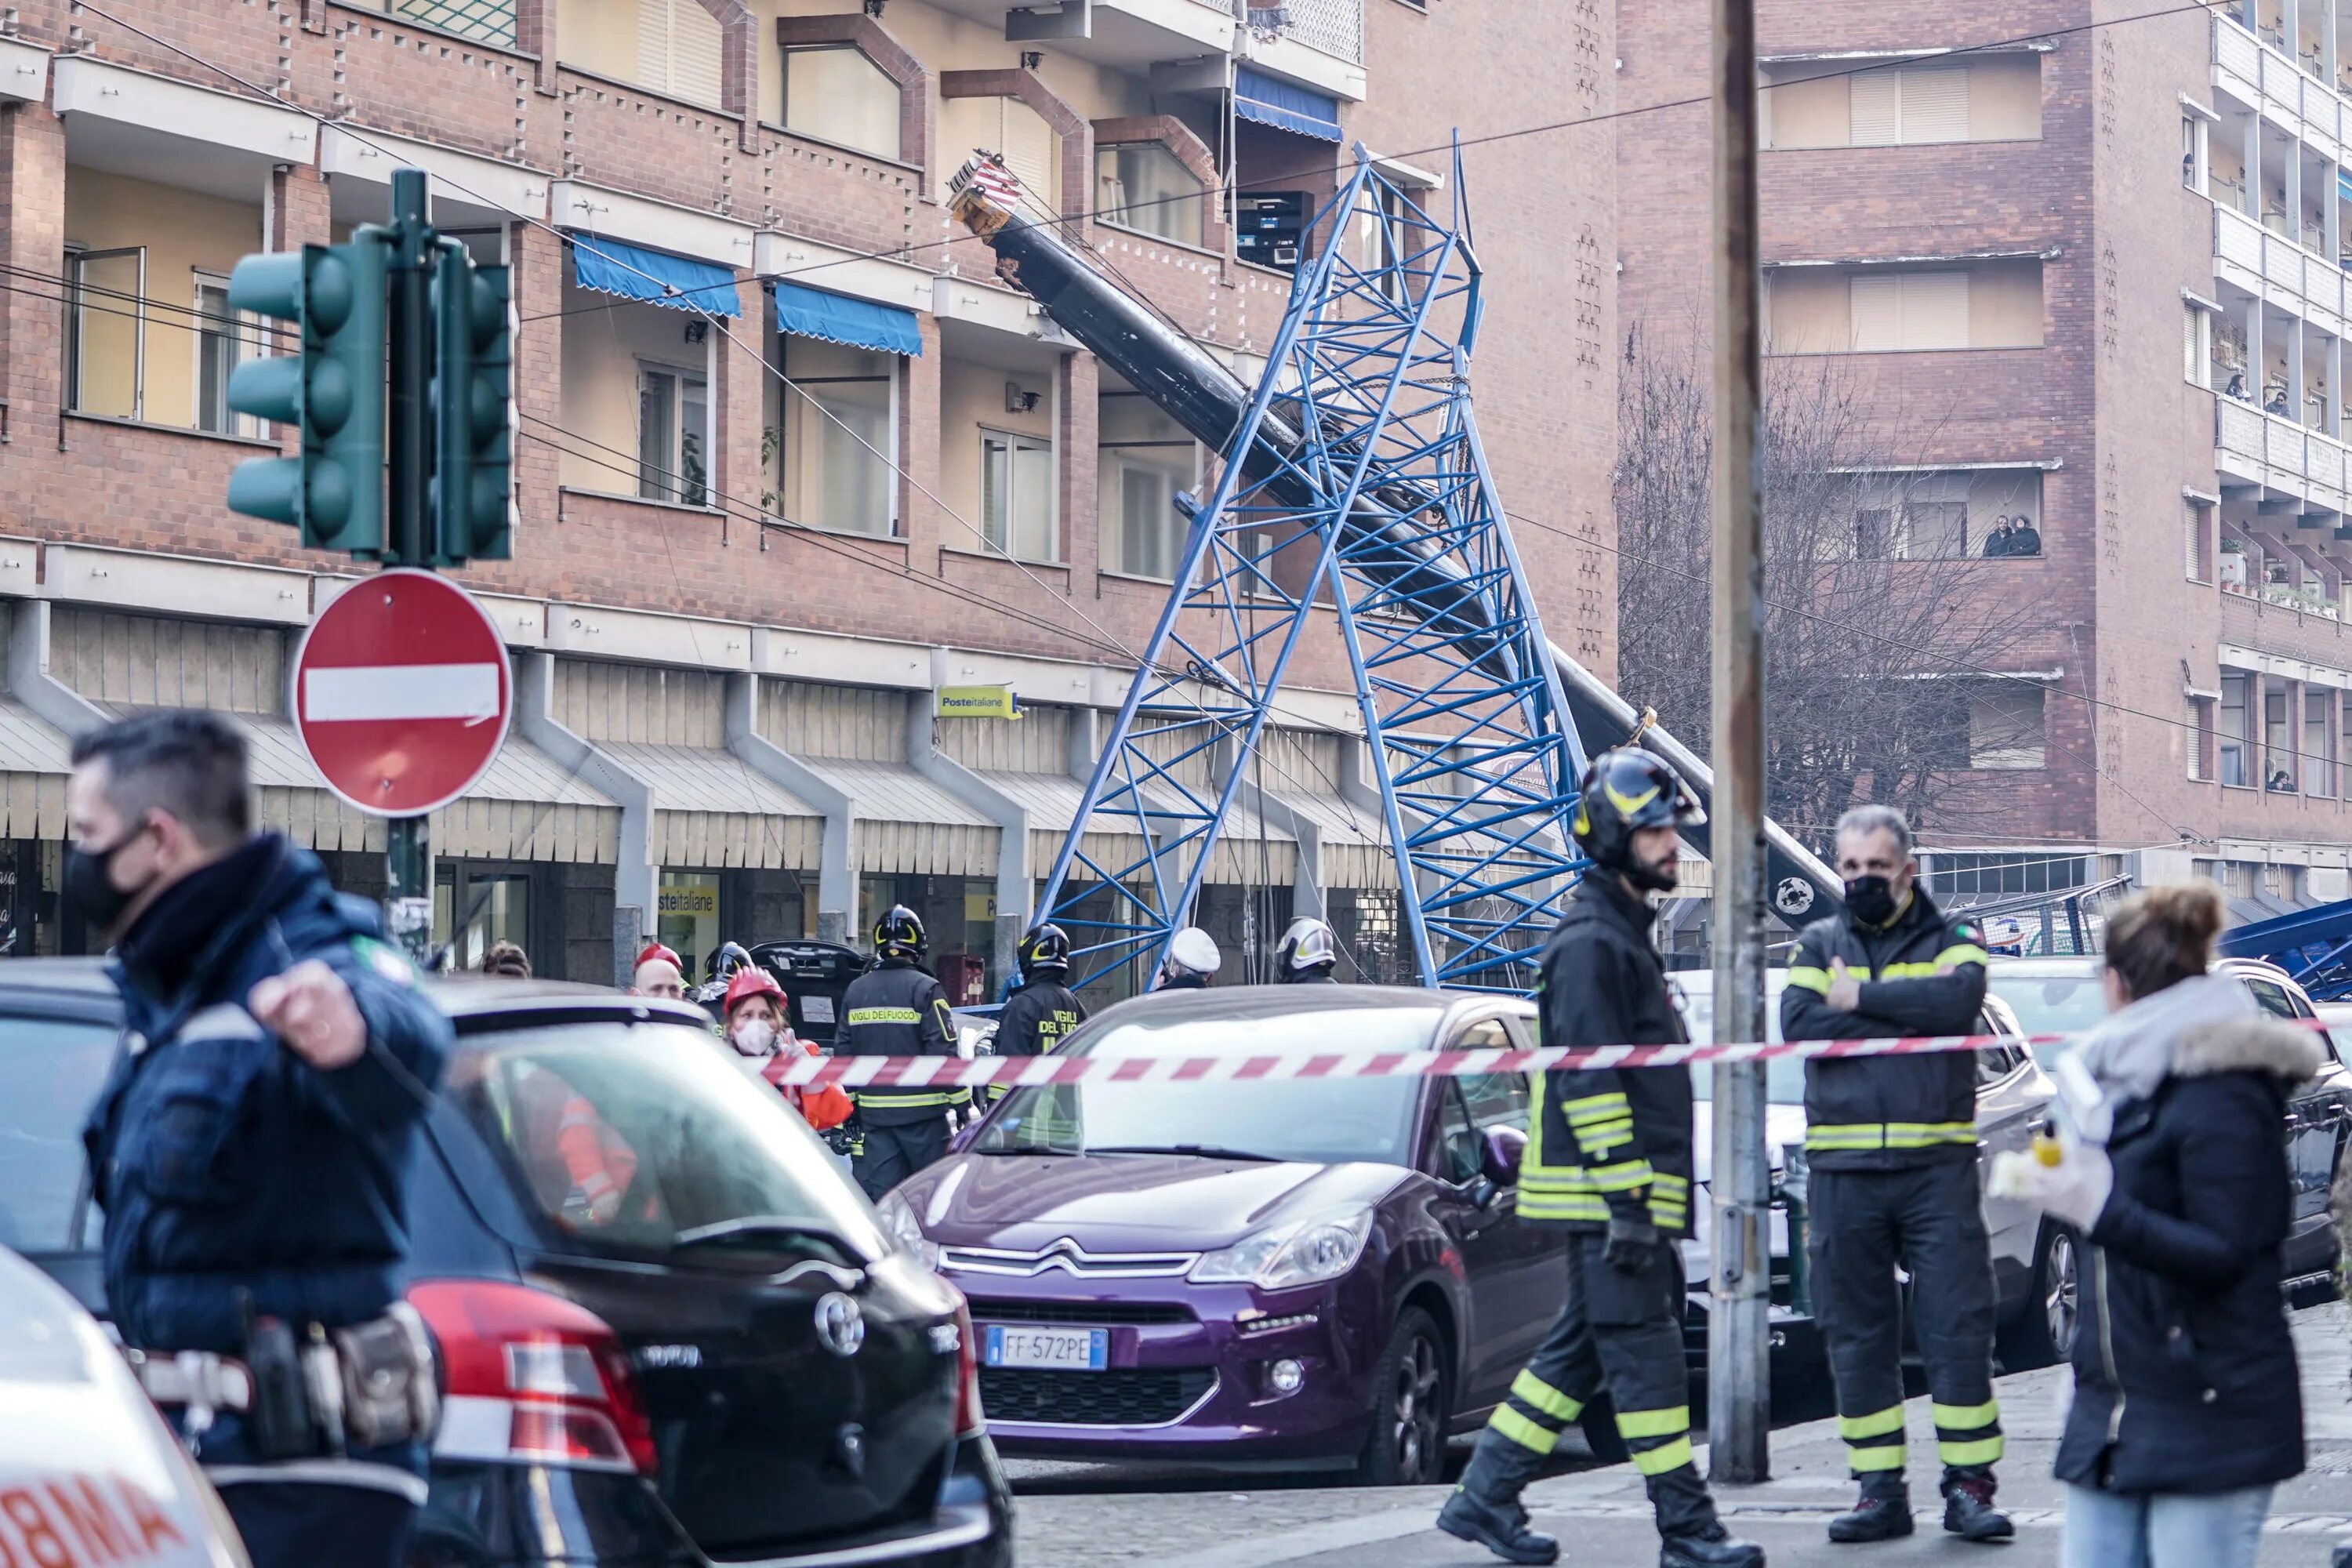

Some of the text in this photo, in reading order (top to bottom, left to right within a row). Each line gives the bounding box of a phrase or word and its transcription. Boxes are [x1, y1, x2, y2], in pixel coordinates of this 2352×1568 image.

[942, 696, 1003, 707] Posteitaliane
[872, 1010, 887, 1020] DEL
[887, 1010, 915, 1020] FUOCO
[1038, 1021, 1058, 1033] DEL
